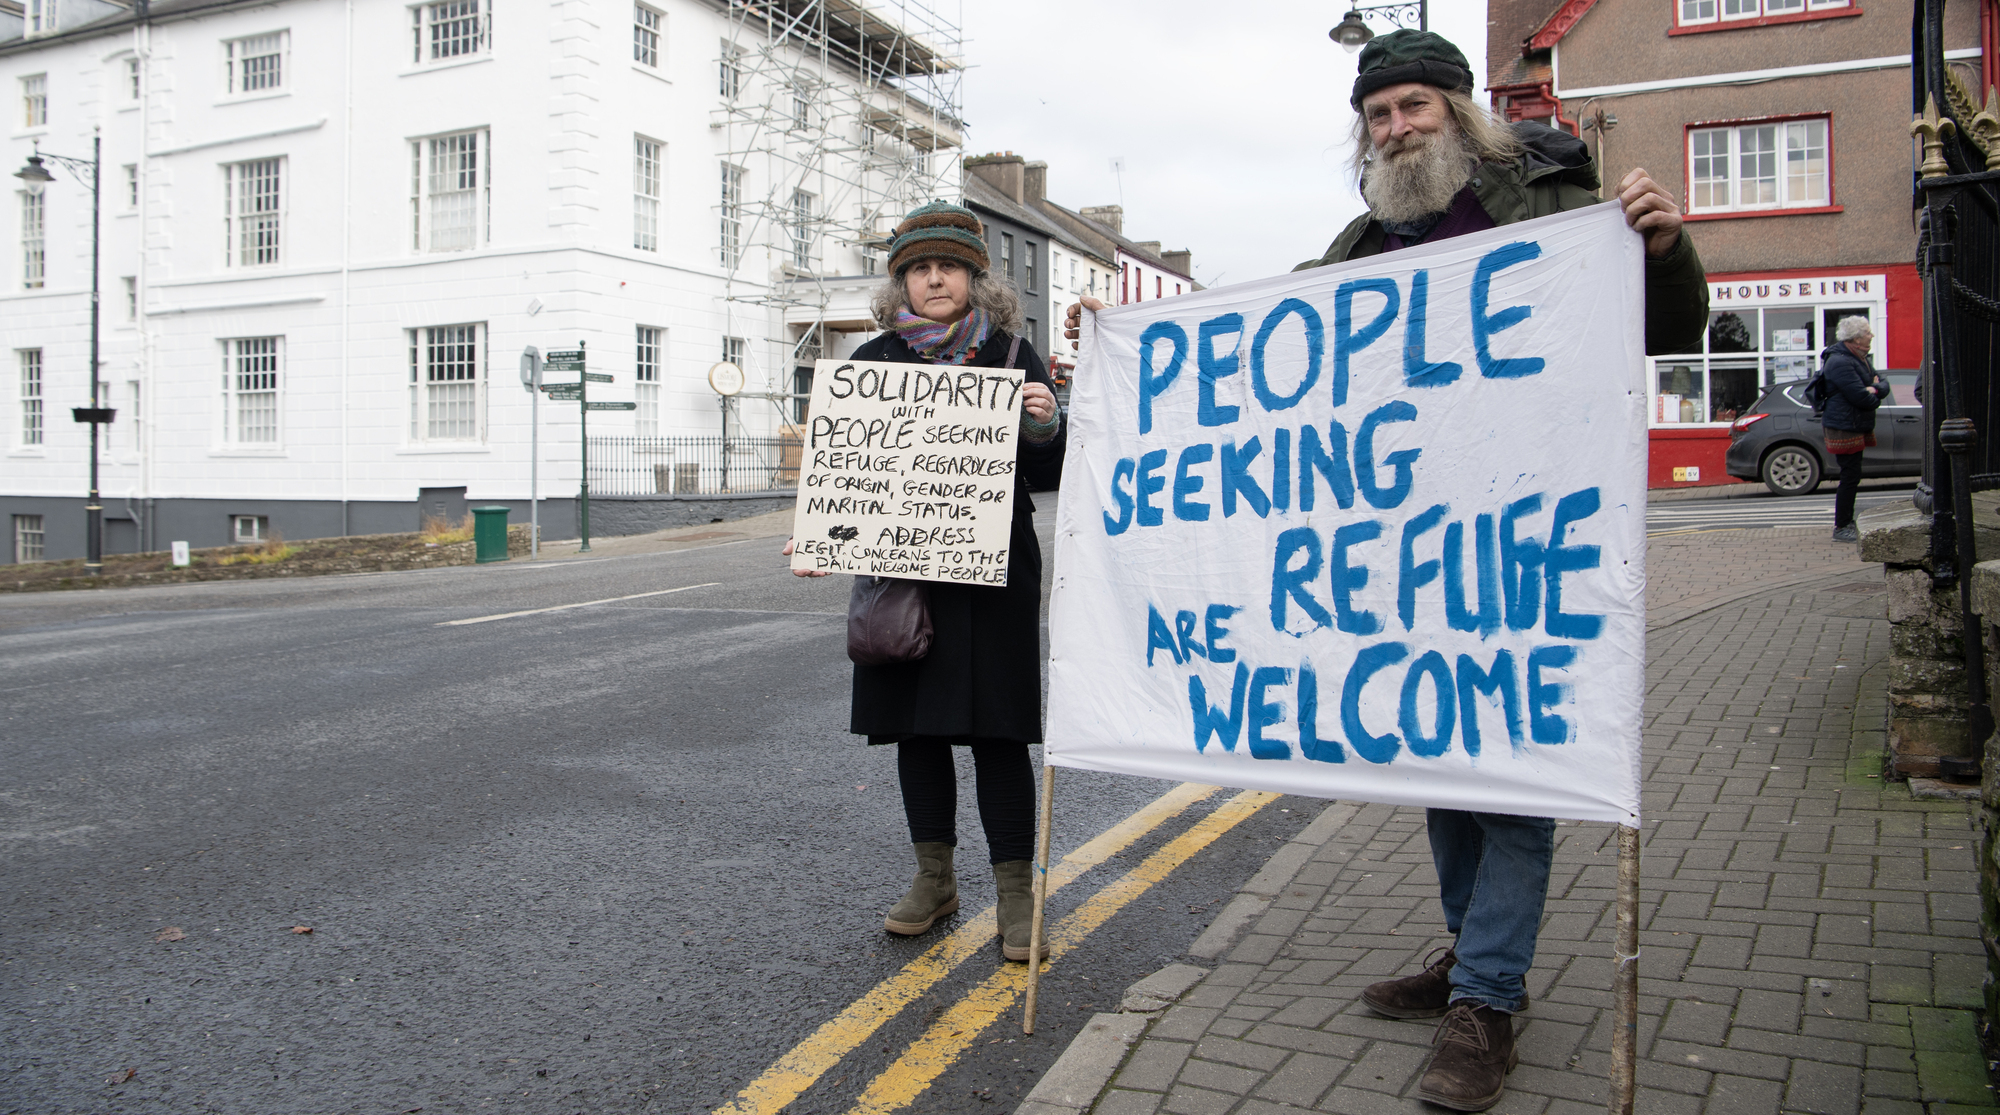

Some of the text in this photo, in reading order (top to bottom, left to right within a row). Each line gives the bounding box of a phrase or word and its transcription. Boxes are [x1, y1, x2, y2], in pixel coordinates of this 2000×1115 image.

[1717, 279, 1869, 300] HOUSE INN
[1139, 241, 1546, 435] PEOPLE
[829, 364, 1023, 411] SOLIDARITY
[892, 405, 935, 419] WITH
[811, 415, 1010, 450] PEOPLE SEEKING
[813, 450, 1015, 477] REFUGE, REGARDLESS
[1102, 400, 1423, 536] SEEKING
[807, 473, 1006, 503] OF ORIGIN, GENDER OR
[807, 497, 976, 521] MARITAL STATUS.
[876, 526, 976, 547] ADDRESS
[851, 545, 931, 561] CONCERNS
[937, 550, 962, 564] TO
[968, 550, 1007, 564] THE
[871, 559, 930, 577] WELCOME
[1270, 486, 1607, 640] REFUGE
[1146, 602, 1244, 667] ARE
[1188, 641, 1585, 764] WELCOME
